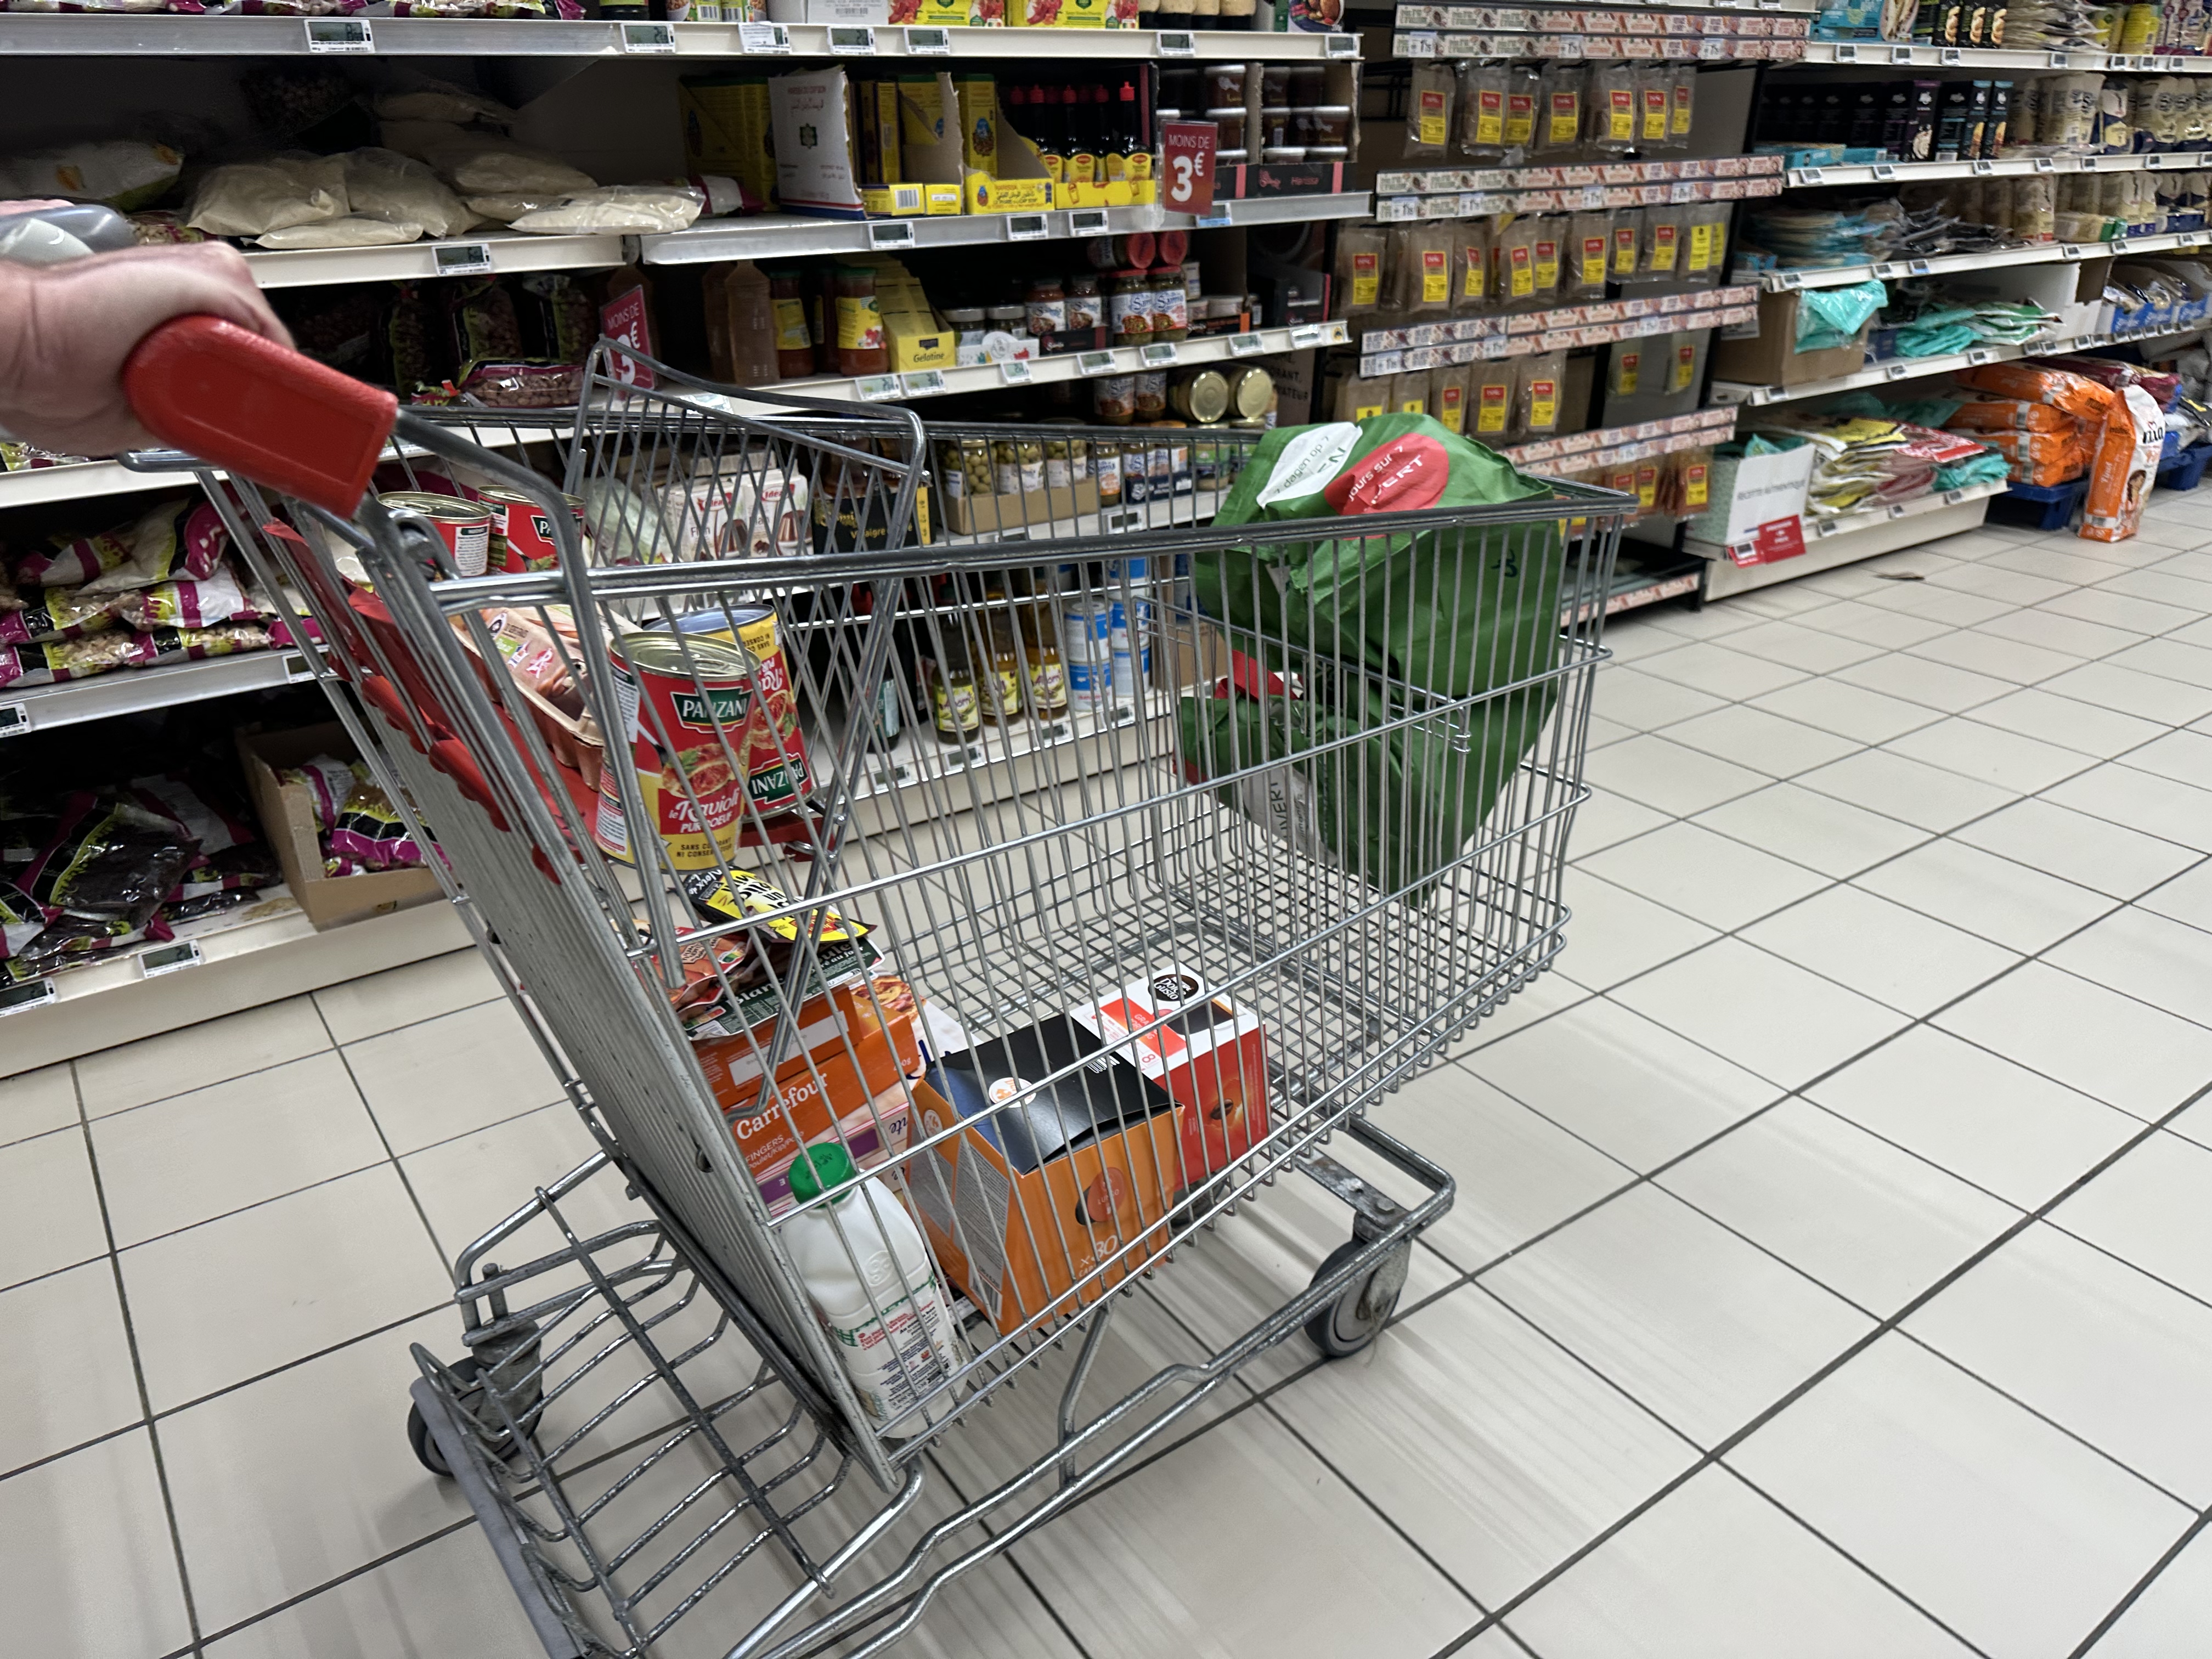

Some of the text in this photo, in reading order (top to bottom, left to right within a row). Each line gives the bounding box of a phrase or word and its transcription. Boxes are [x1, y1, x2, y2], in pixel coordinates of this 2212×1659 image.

[1169, 134, 1210, 149] MOINS DE
[630, 302, 640, 319] DE
[1284, 458, 1311, 488] dagen
[1310, 444, 1323, 457] op
[1348, 471, 1374, 502] jours
[1374, 454, 1392, 473] sur
[682, 698, 747, 719] PAZANI
[751, 762, 805, 794] PAZANI
[844, 946, 864, 959] for
[1154, 982, 1178, 1000] Gusto
[737, 1073, 828, 1139] Carrefour
[746, 1135, 784, 1163] FINGERS
